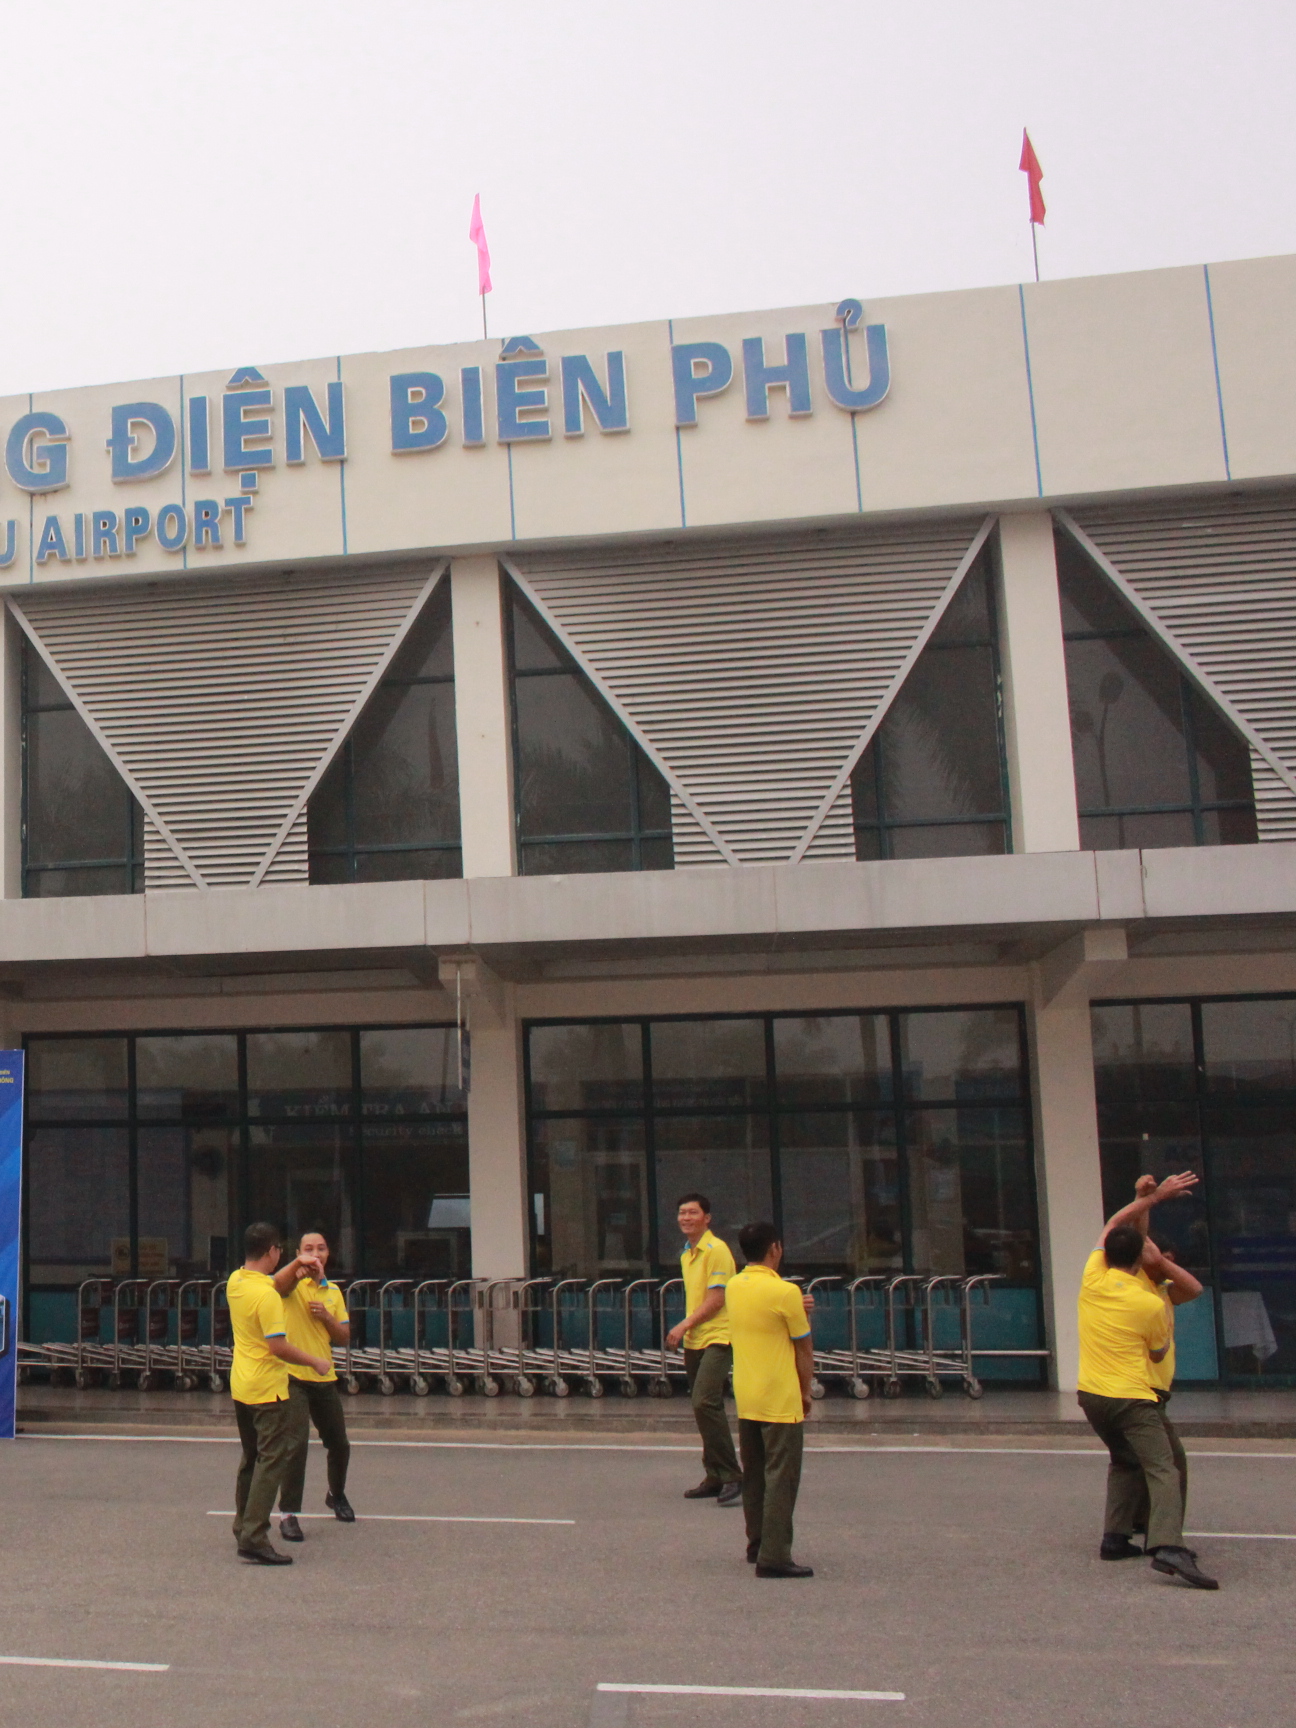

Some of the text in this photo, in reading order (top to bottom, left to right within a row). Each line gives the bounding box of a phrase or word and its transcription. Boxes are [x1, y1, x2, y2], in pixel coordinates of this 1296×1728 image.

[106, 366, 347, 493] ĐIỆN
[389, 336, 630, 456] BIÊN
[671, 298, 892, 428] PHỦ
[36, 495, 254, 564] AIRPORT
